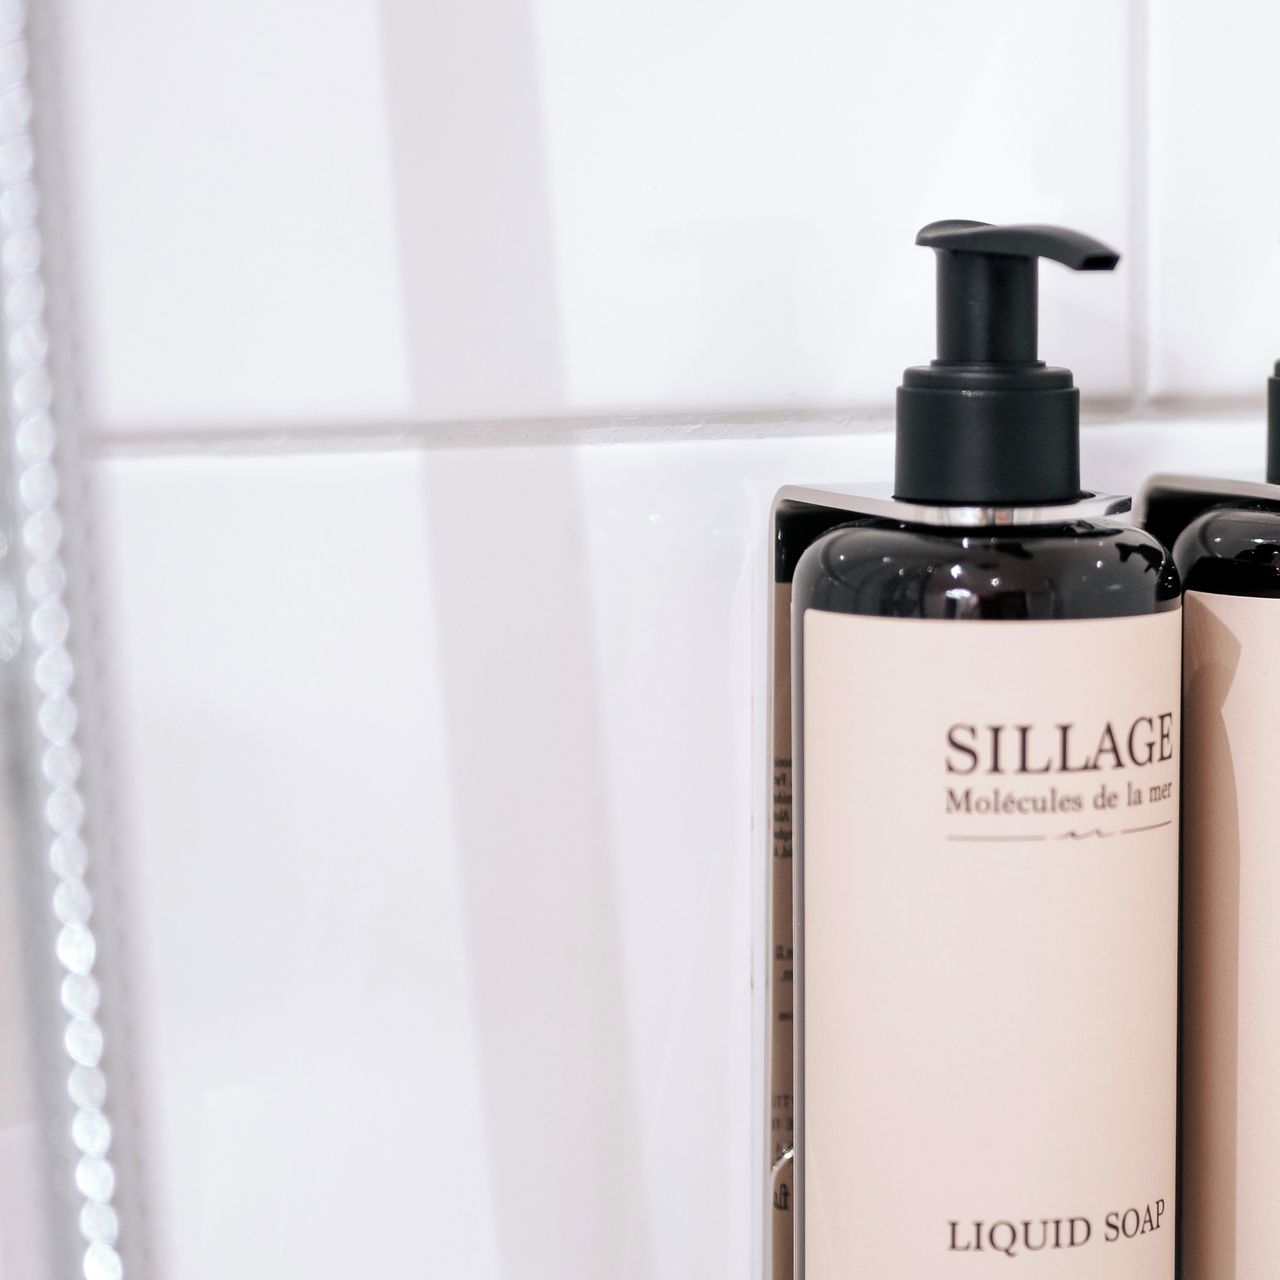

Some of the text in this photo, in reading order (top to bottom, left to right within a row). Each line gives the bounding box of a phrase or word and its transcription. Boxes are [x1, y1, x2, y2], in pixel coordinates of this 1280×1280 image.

[945, 711, 1174, 776] SILLAGE
[945, 781, 1173, 815] Molécules de la mer
[948, 1199, 1165, 1258] LIQUID SOAP
